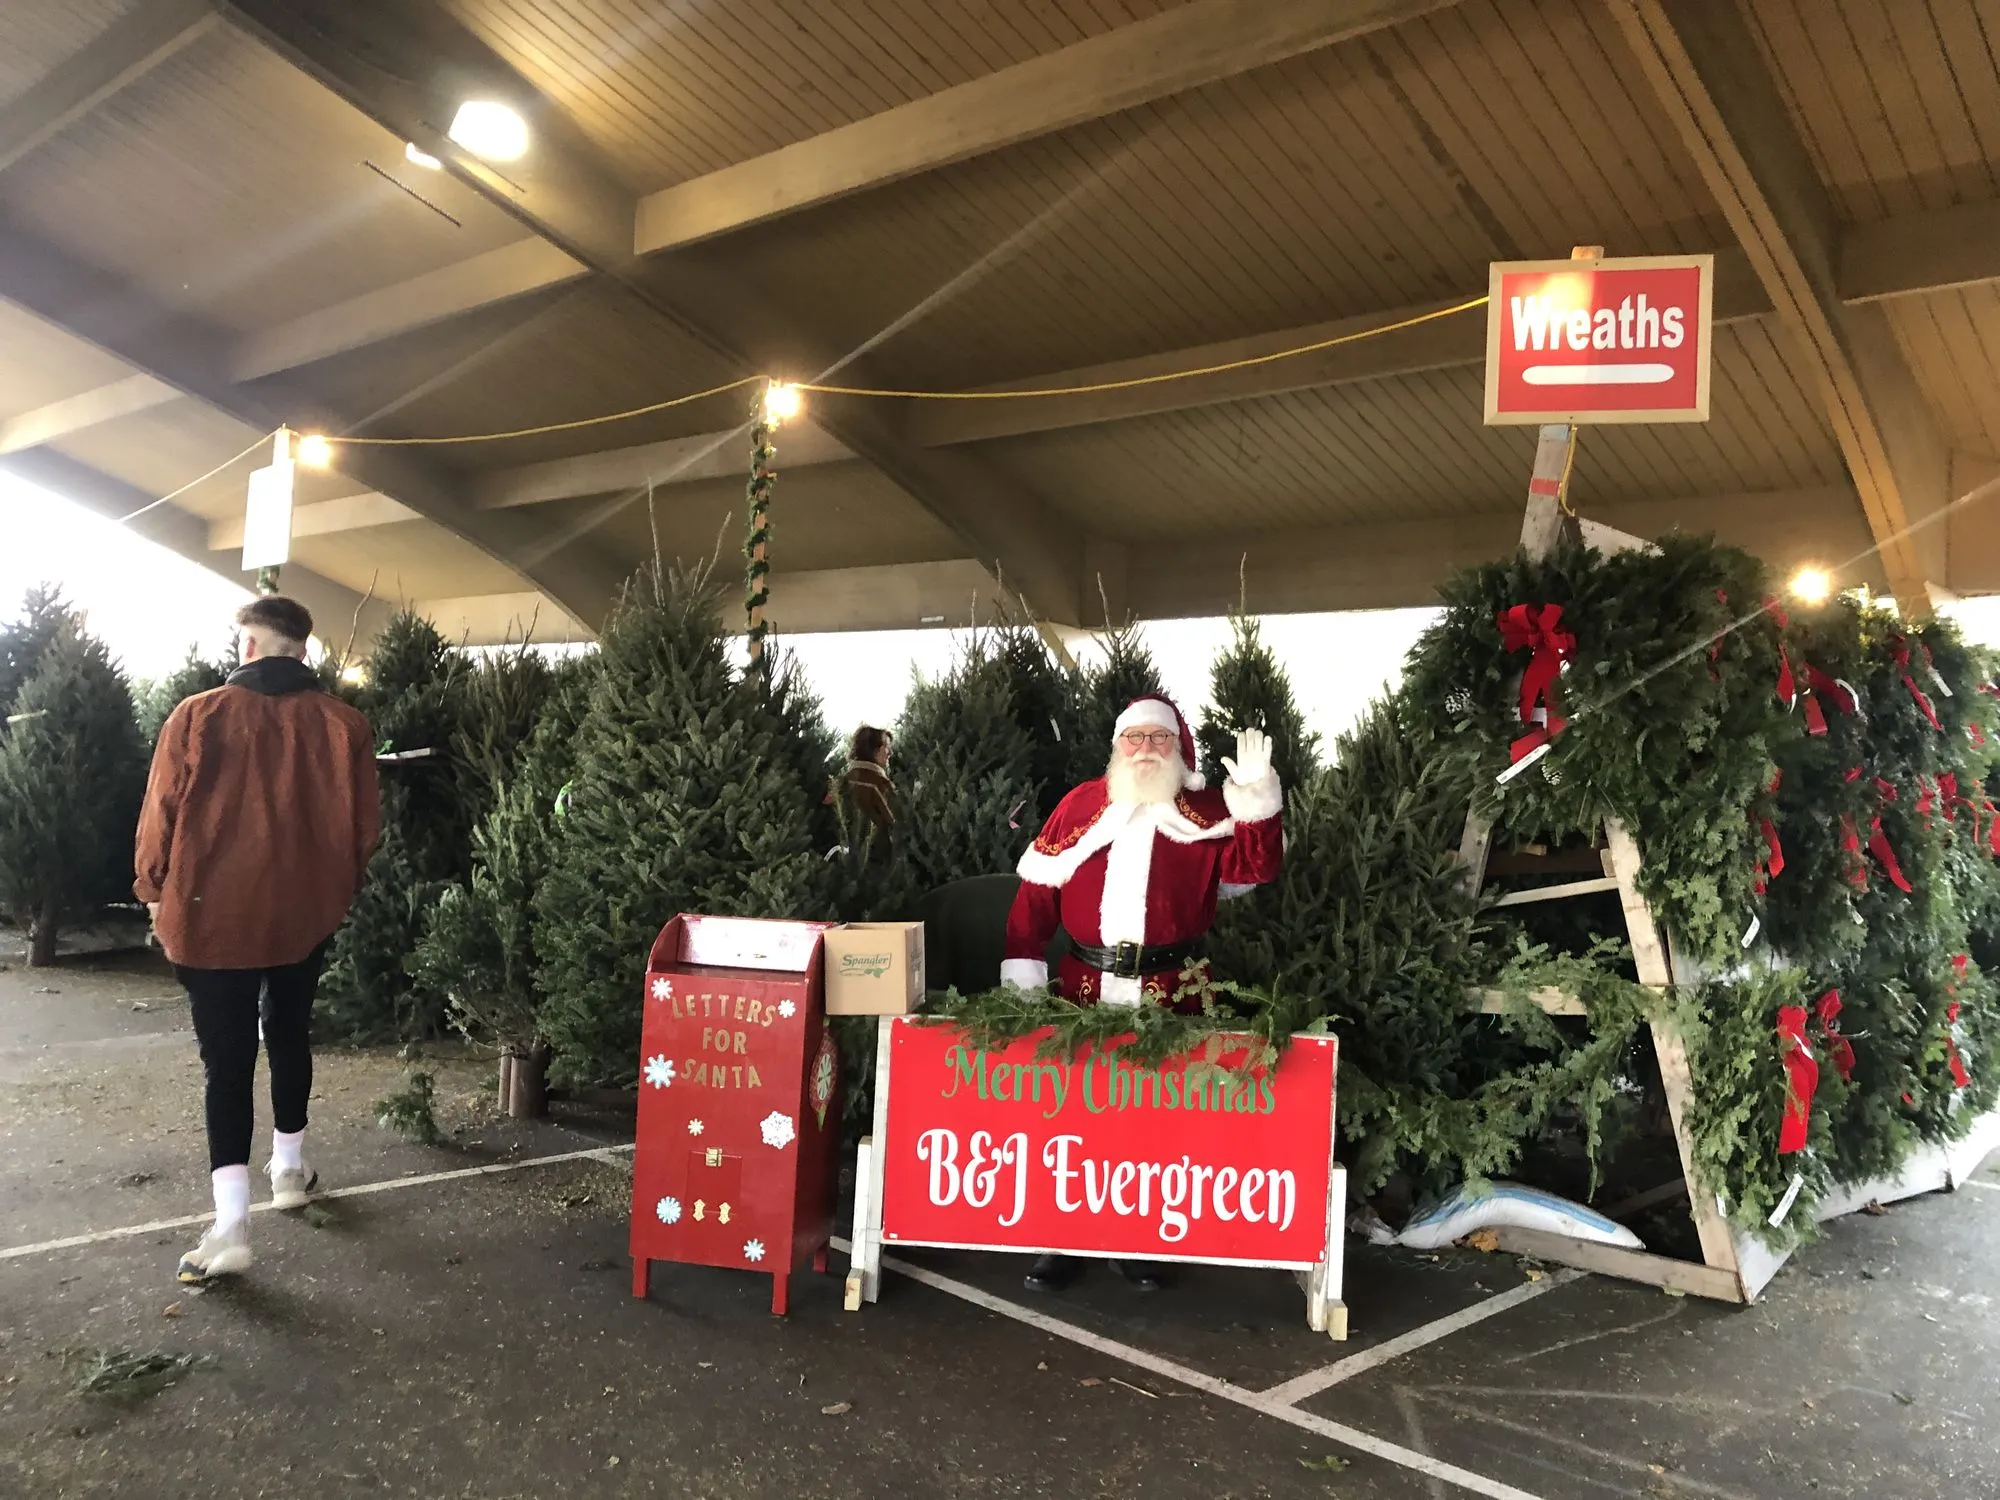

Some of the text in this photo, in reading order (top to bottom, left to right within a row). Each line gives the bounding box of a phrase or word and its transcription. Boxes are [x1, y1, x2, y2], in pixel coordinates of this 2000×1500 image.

[1510, 293, 1685, 351] Wreaths
[842, 954, 889, 967] Spangler
[671, 993, 777, 1028] LETTERS
[702, 1027, 747, 1054] FOR
[680, 1058, 762, 1089] SANTA
[941, 1045, 1276, 1119] Merry Christmas
[916, 1128, 1297, 1243] B&J Evergreen
